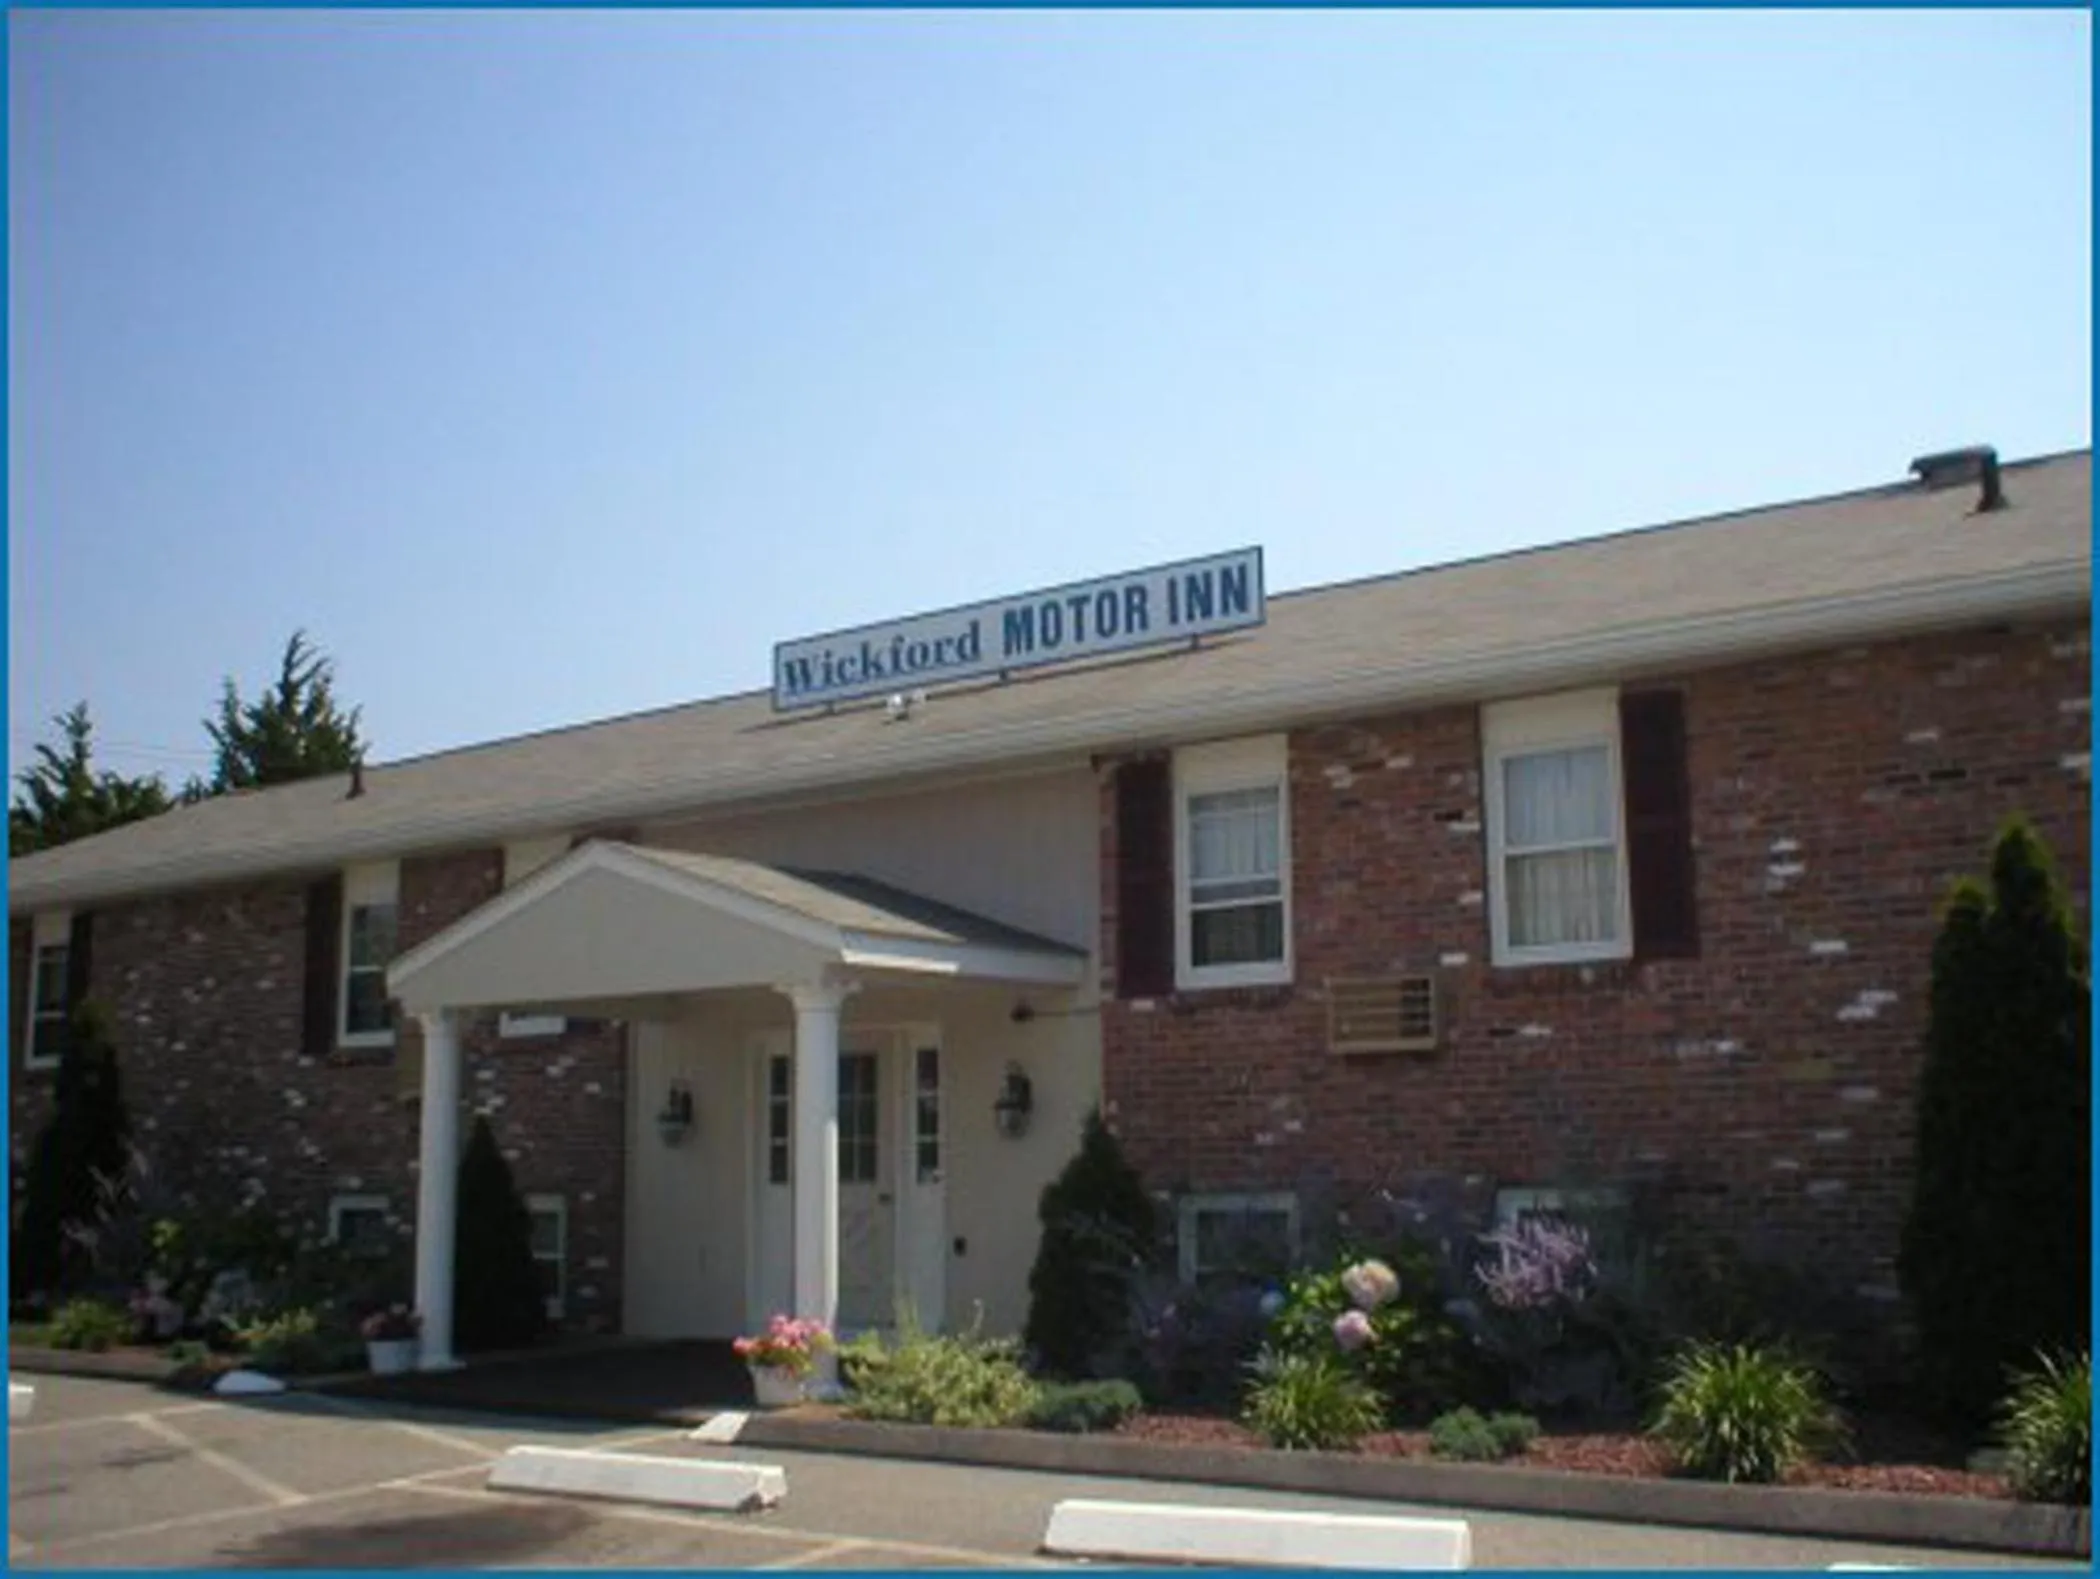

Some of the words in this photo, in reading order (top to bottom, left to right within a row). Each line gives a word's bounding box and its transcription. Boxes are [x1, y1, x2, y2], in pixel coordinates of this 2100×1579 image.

[783, 620, 981, 695] Wickford
[1003, 584, 1149, 657] MOTOR
[1168, 563, 1249, 625] INN
